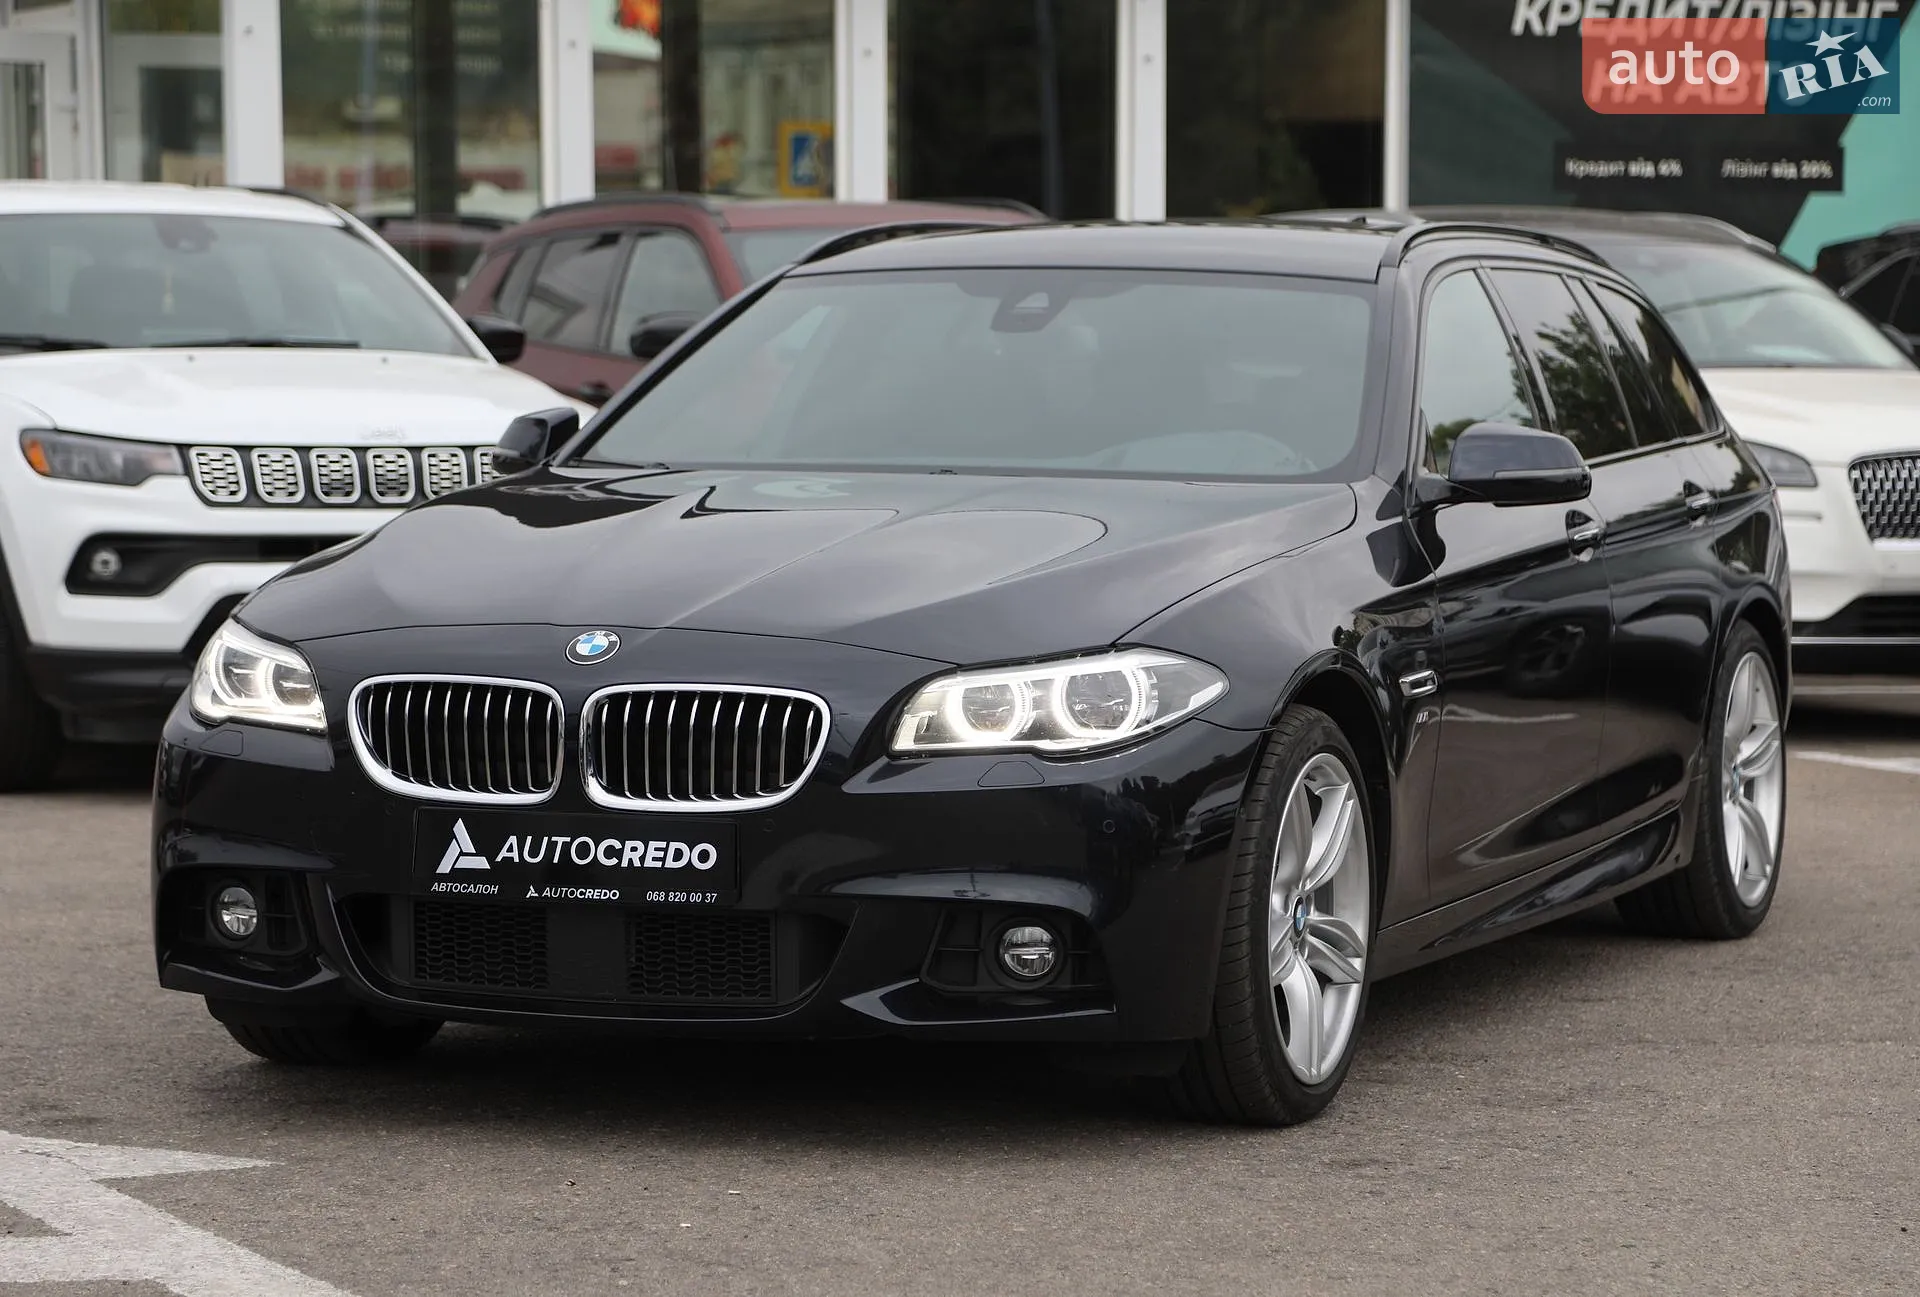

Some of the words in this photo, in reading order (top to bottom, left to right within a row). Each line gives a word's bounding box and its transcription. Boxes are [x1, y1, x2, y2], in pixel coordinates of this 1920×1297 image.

[495, 835, 718, 870] AUTOCREDO
[431, 882, 499, 894] АВТОСАЛОН
[541, 887, 620, 900] AUTOCREDO
[646, 891, 666, 902] 068
[668, 891, 687, 902] 820
[689, 892, 703, 903] 00
[705, 893, 718, 904] 37
